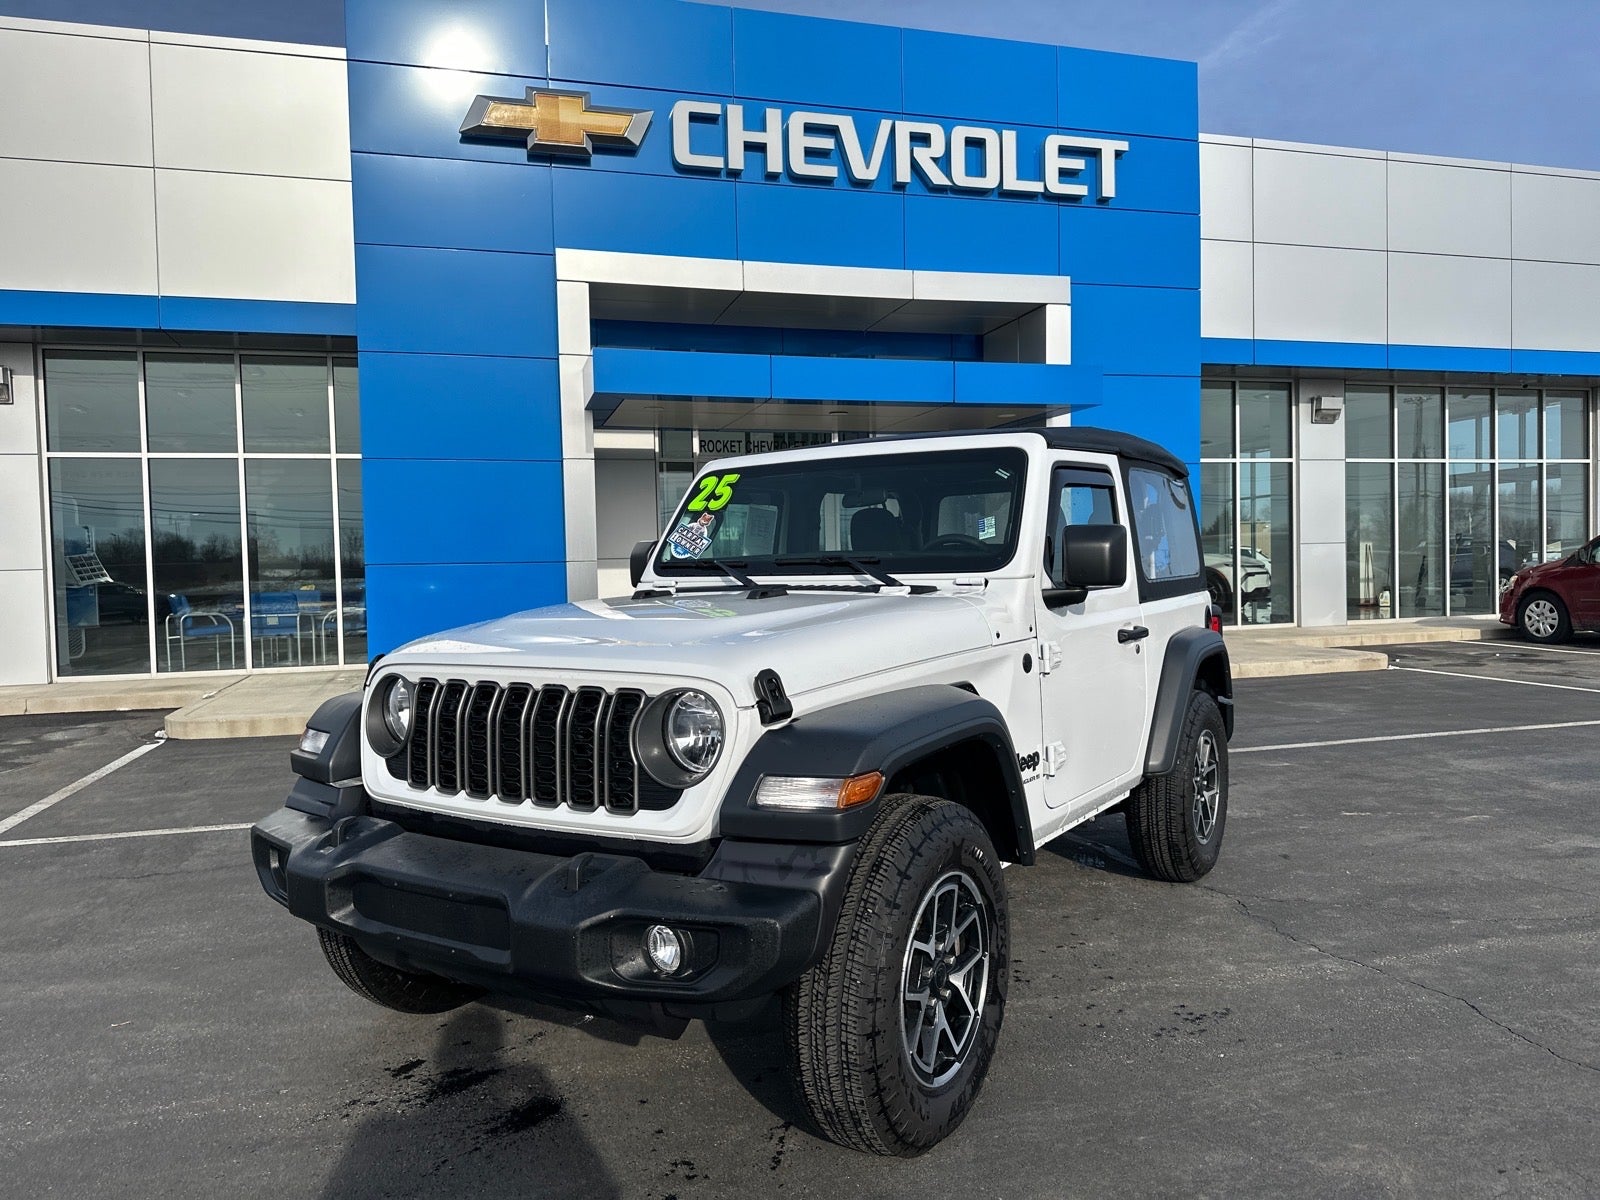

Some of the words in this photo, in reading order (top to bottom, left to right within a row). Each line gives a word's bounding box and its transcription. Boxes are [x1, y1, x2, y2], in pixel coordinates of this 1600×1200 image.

[670, 99, 1129, 203] CHEVROLET
[700, 440, 742, 453] ROCKET
[687, 474, 740, 512] 25
[676, 535, 701, 555] OWNER
[678, 526, 708, 548] CARFAX
